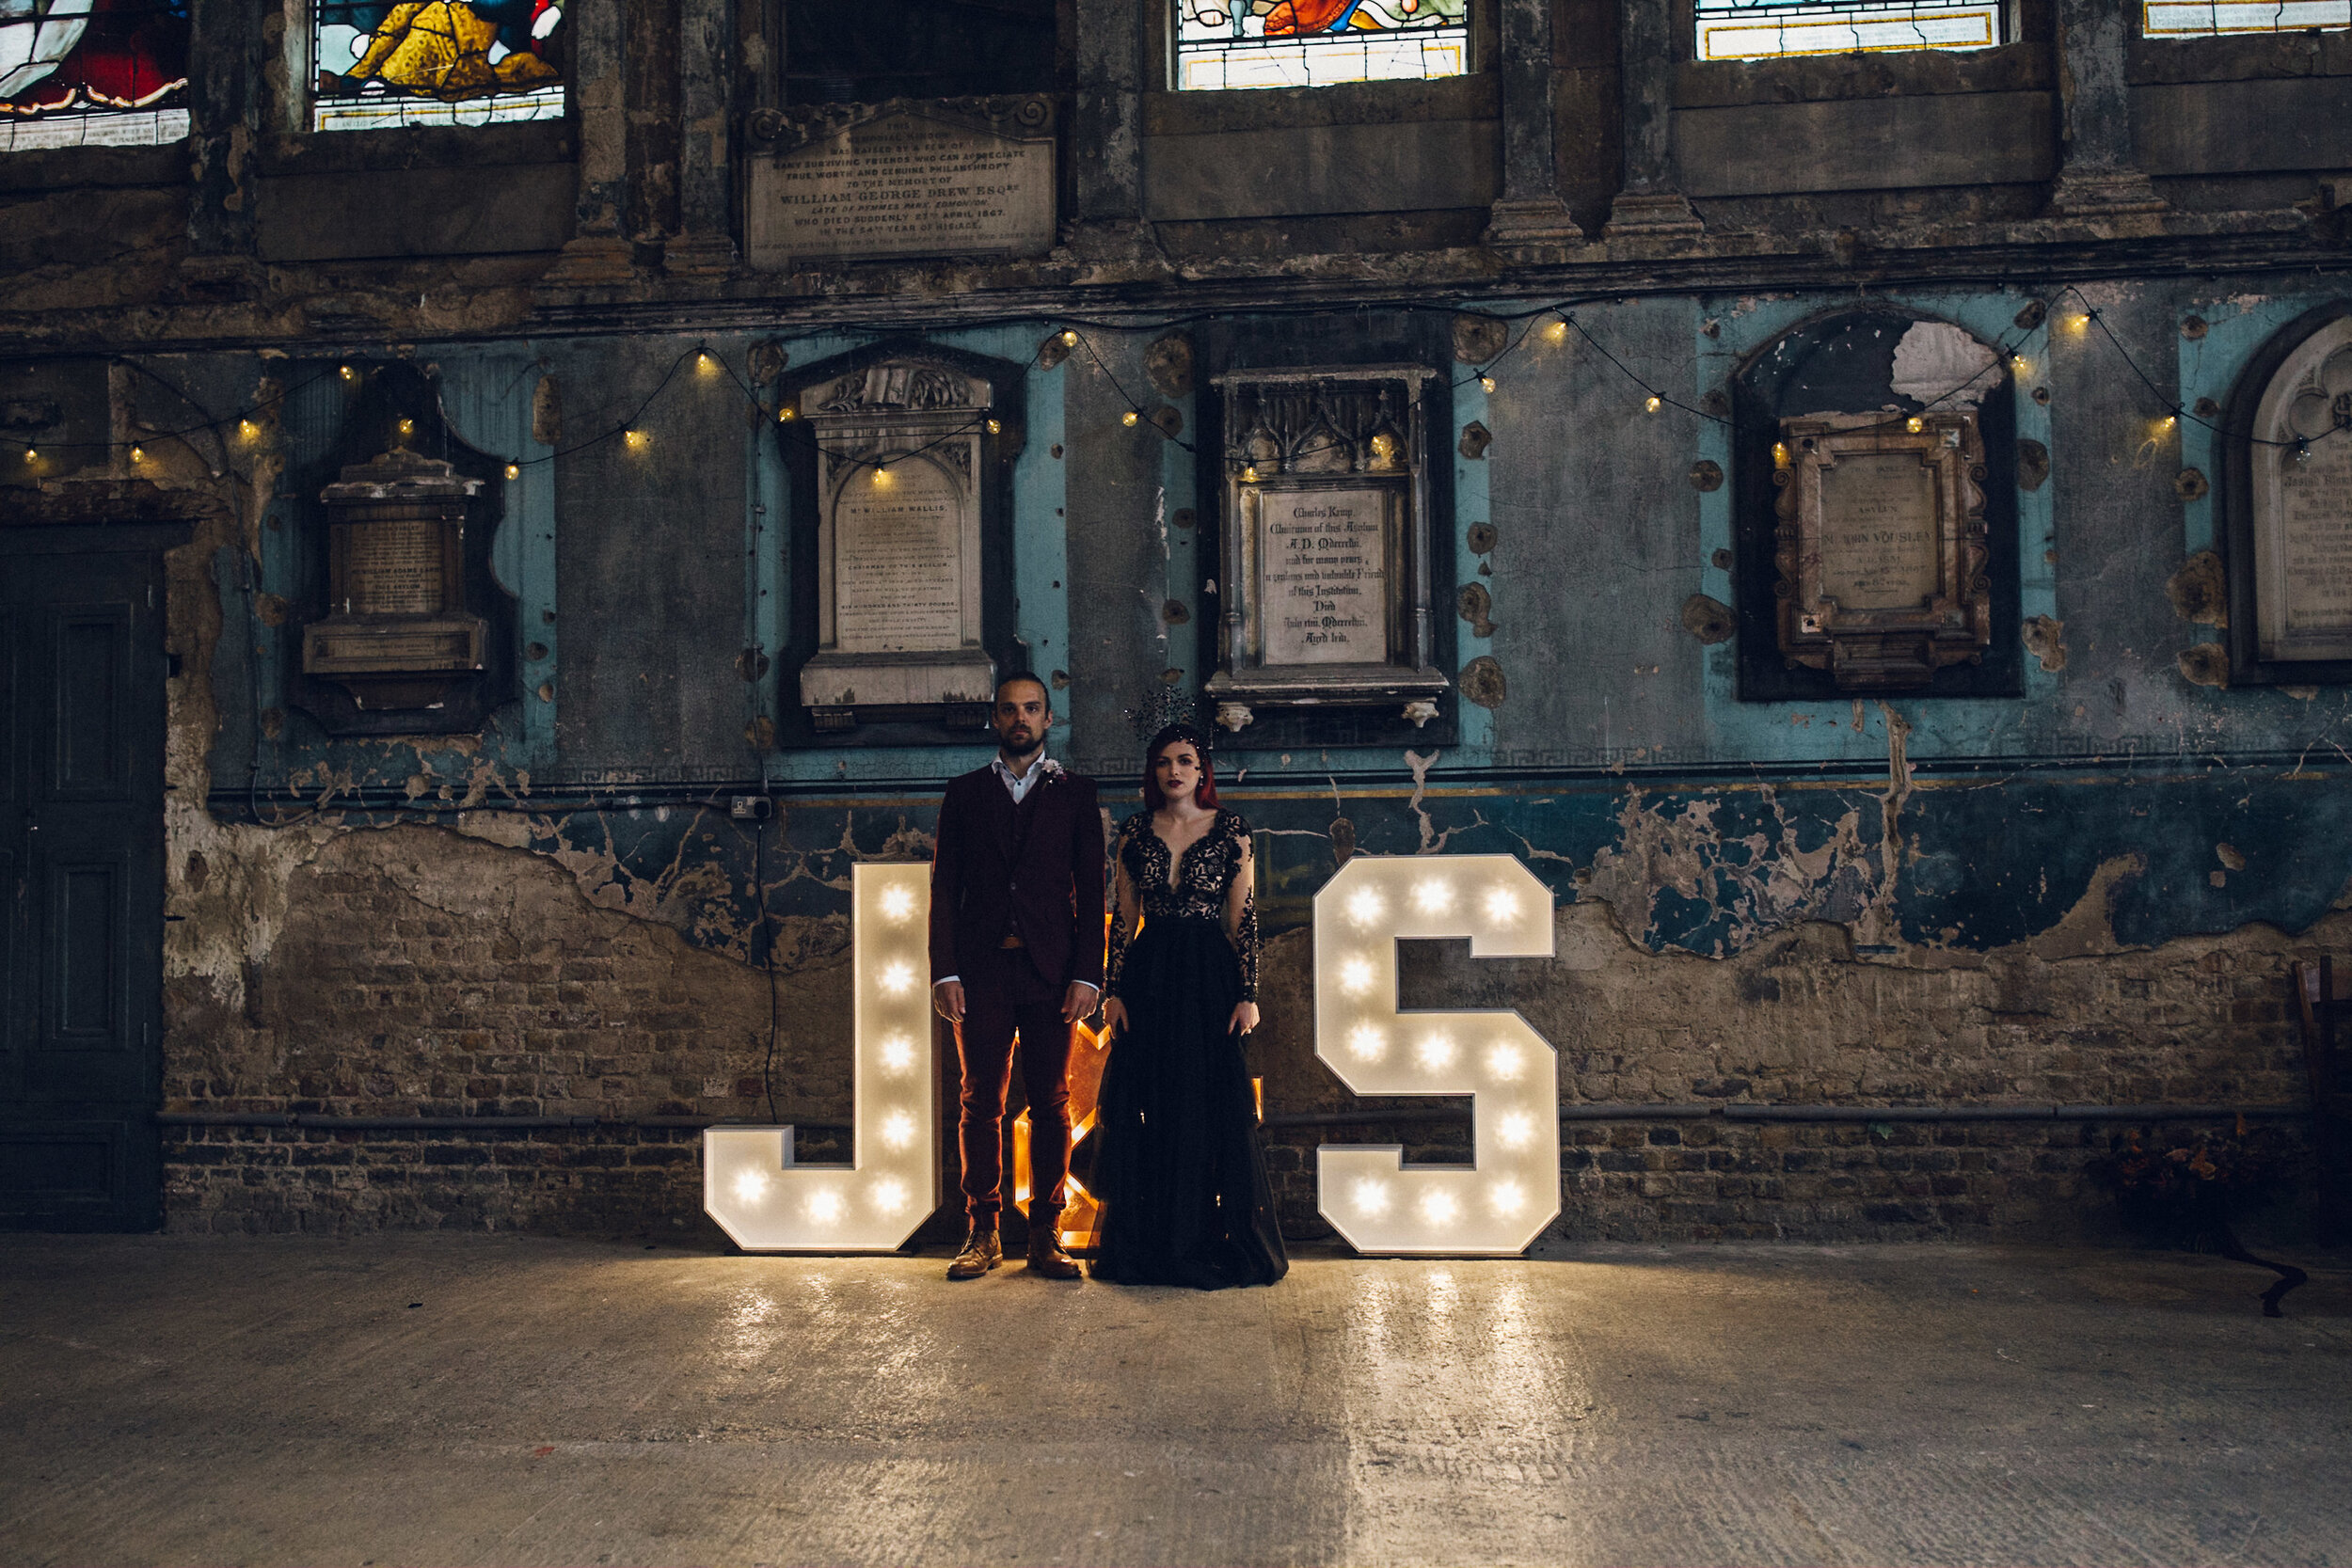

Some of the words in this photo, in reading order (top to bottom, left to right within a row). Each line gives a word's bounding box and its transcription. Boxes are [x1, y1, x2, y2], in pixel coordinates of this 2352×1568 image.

[854, 146, 891, 154] RAISED
[804, 158, 860, 167] SURVIVING
[866, 156, 910, 166] FRIENDS
[914, 154, 936, 163] WHO
[940, 153, 959, 162] CAN
[962, 150, 1025, 160] APPRECIATE
[816, 170, 852, 179] WORTH
[857, 168, 879, 177] AND
[882, 165, 924, 175] GENUINE
[930, 163, 1009, 173] PHILANTHROPY
[888, 177, 936, 186] MEMORY
[780, 192, 851, 204] WILLIAM
[858, 189, 921, 200] GEORGE
[928, 187, 970, 198] DREW
[811, 206, 837, 214] LATE
[794, 217, 818, 227] WHO
[823, 216, 850, 225] DIED
[854, 213, 909, 223] SUDDENLY
[943, 210, 974, 219] APRIL
[835, 227, 854, 235] THE
[887, 224, 915, 232] YEAR
[920, 223, 932, 231] OF
[1293, 507, 1327, 518] Charles
[1270, 523, 1312, 534] Chairman
[1314, 522, 1324, 532] of
[1325, 522, 1341, 532] this
[1343, 521, 1378, 532] Asylum
[1285, 554, 1300, 564] and
[1302, 554, 1314, 564] for
[1315, 556, 1339, 565] many
[1305, 570, 1319, 580] and
[1321, 569, 1355, 580] valuable
[1356, 568, 1385, 581] Friend
[1288, 585, 1296, 596] of
[1297, 585, 1314, 596] this
[1312, 600, 1336, 613] Died
[1301, 632, 1328, 646] Aged
[704, 862, 941, 1252] J
[1312, 854, 1561, 1255] S
